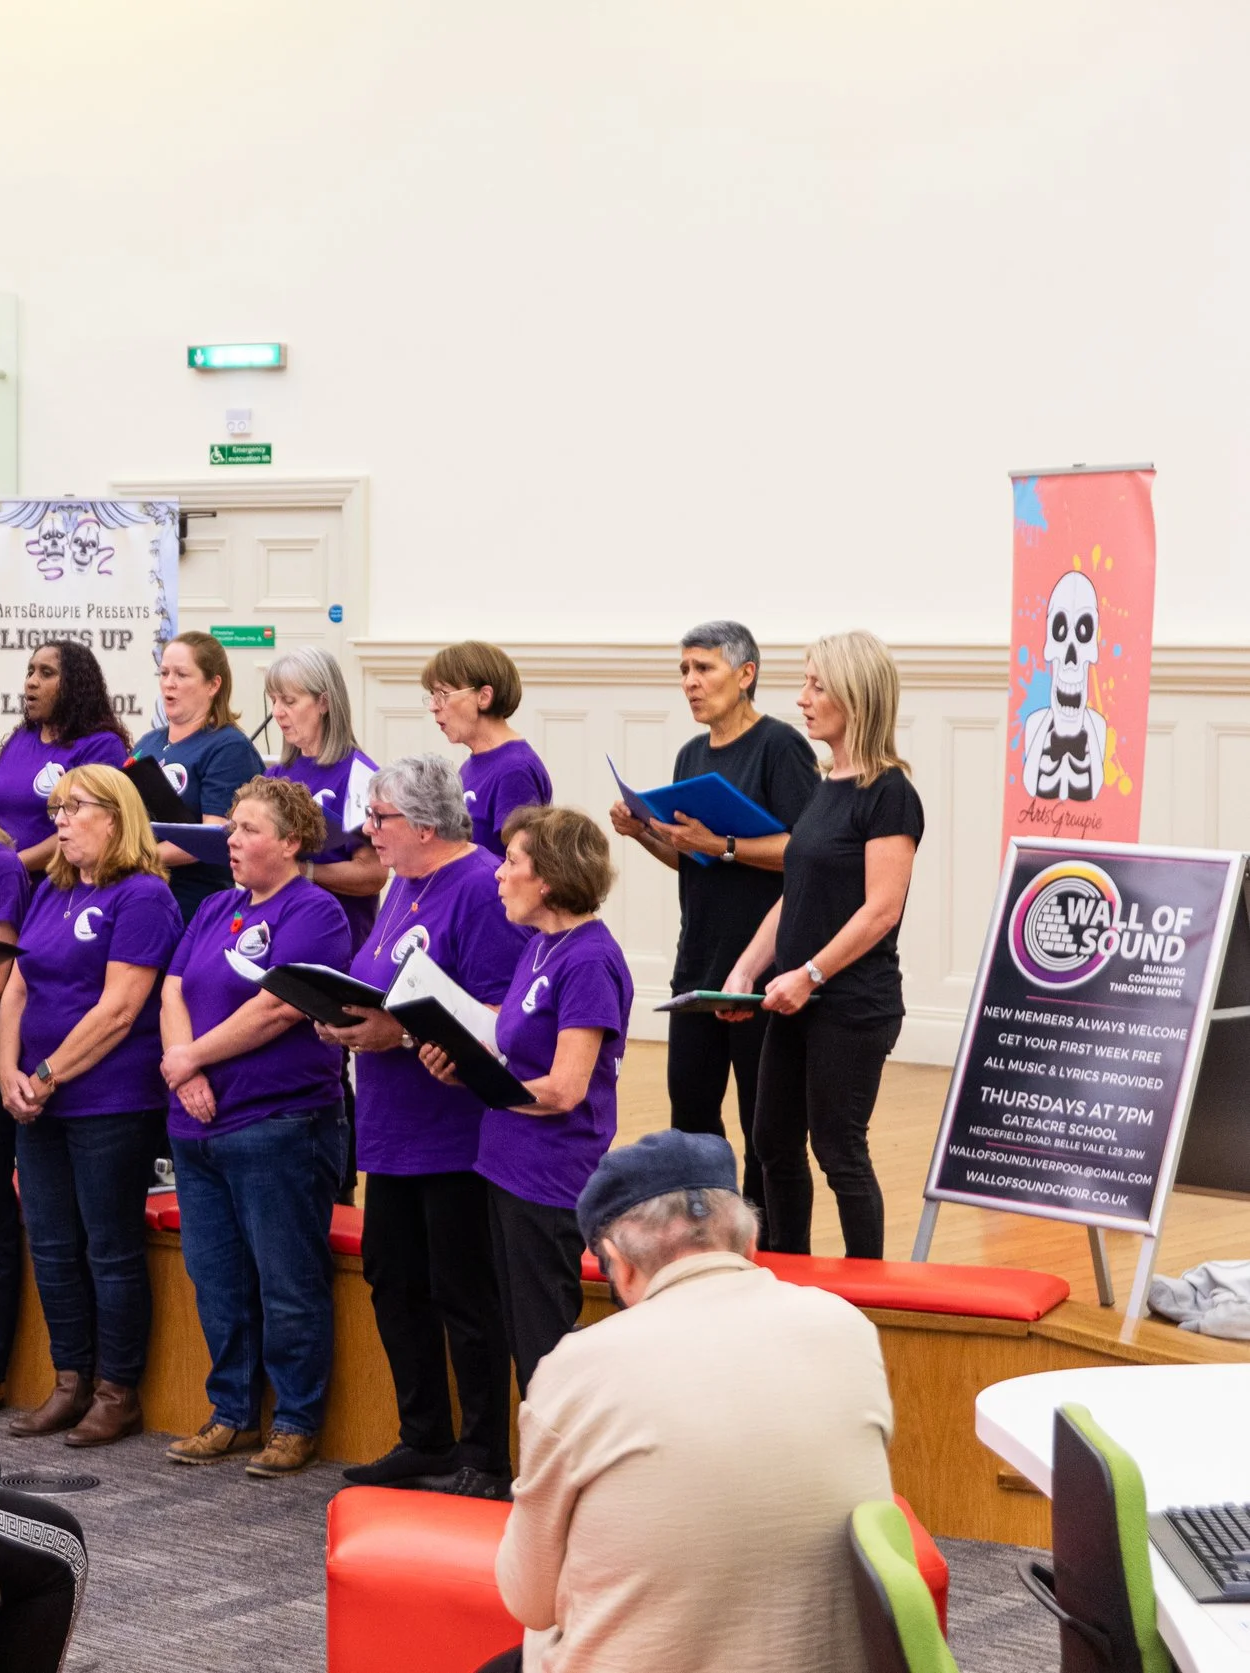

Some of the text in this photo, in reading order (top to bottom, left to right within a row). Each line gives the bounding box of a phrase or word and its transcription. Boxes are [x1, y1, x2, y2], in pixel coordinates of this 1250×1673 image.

[100, 628, 134, 650] UP
[1017, 798, 1103, 839] ArtsGroupie
[1067, 897, 1193, 934] WALL OF
[1079, 928, 1186, 963] SOUND
[1128, 973, 1184, 987] COMMUNITY
[1143, 964, 1186, 976] BUILDING
[1110, 982, 1181, 998] THROUGH SONG
[983, 1005, 1189, 1041] NEW MEMBERS ALWAYS WELCOME
[998, 1032, 1162, 1064] GET YOUR FIRST WEEK FREE
[984, 1056, 1164, 1091] ALL MUSIC & LYRICS PROVIDED
[980, 1085, 1154, 1126] THURSDAYS AT 7PM
[969, 1125, 1024, 1142] HEDGEFIELD
[1054, 1138, 1080, 1151] BELLE
[1107, 1146, 1123, 1158] L25
[1125, 1148, 1146, 1160] 2RW
[1002, 1113, 1118, 1142] GATEACRE SCHOOL
[949, 1143, 1152, 1185] WALLOFSOUNDLIVERPOOL@GMAIL.COM
[966, 1169, 1129, 1206] WALLOFSOUNDCHOIR.CO.UK
